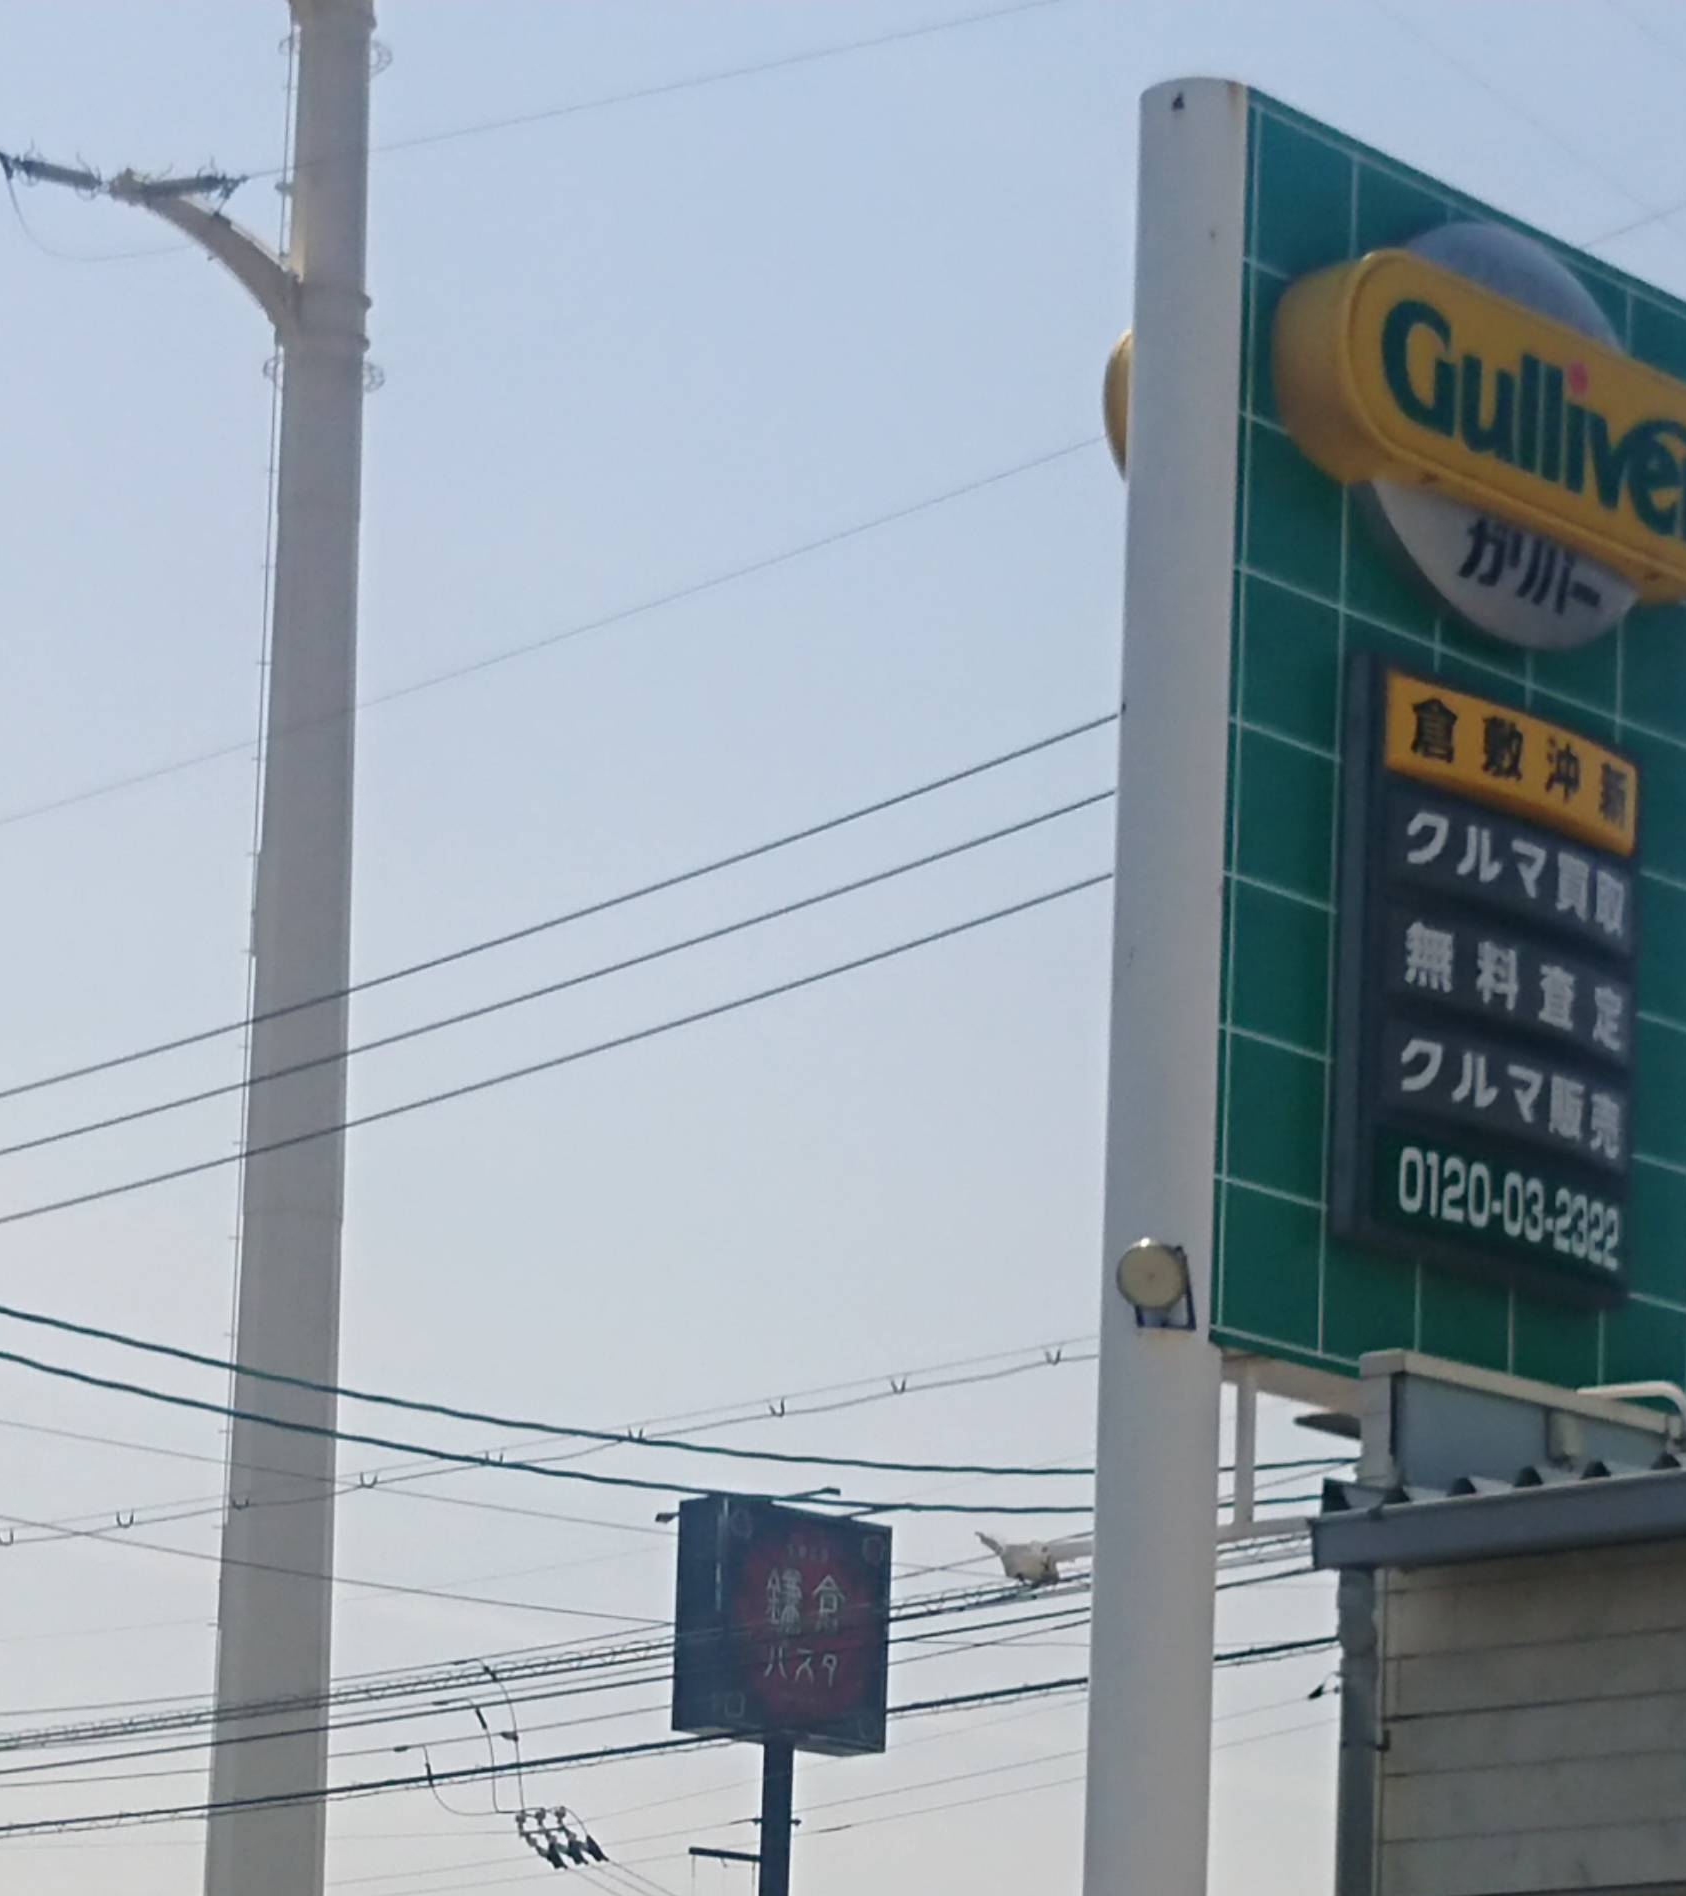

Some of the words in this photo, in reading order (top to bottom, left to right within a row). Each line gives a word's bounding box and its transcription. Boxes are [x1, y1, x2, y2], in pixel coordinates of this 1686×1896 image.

[1405, 810, 1625, 937] クルマ買取
[1403, 921, 1624, 1054] 無料査定
[1399, 1037, 1621, 1161] クルマ販売
[1398, 1145, 1620, 1273] 0120-03-2322
